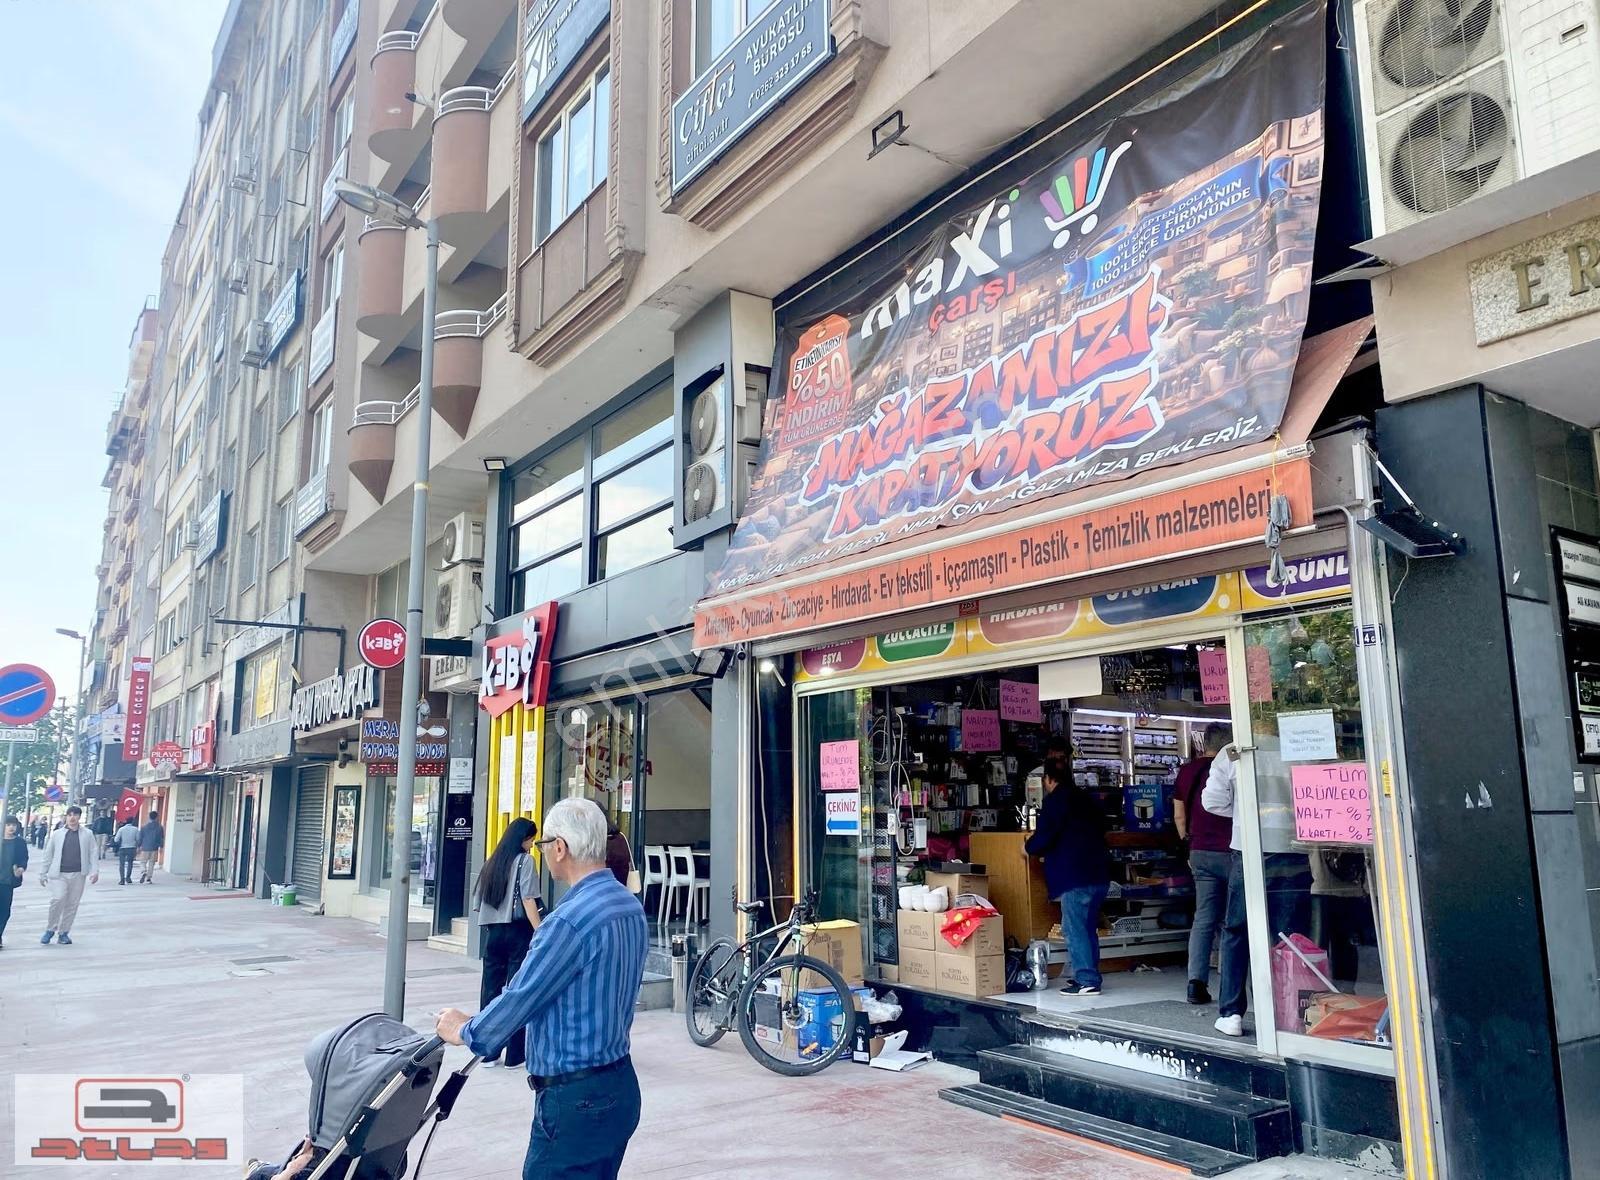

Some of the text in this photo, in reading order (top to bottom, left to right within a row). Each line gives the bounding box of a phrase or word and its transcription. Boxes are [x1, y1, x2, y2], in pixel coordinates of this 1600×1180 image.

[774, 65, 790, 83] 323
[1163, 187, 1251, 241] ÜRÜNÜNDE
[1166, 178, 1242, 228] FİRMANIN
[792, 351, 846, 406] %50
[831, 582, 872, 610] Hırdavat
[880, 572, 894, 599] Ev
[1020, 528, 1070, 570] Plastik
[1082, 511, 1151, 555] Temizlik
[1323, 766, 1367, 783] TÜM
[827, 799, 857, 815] ÇEKİNİZ
